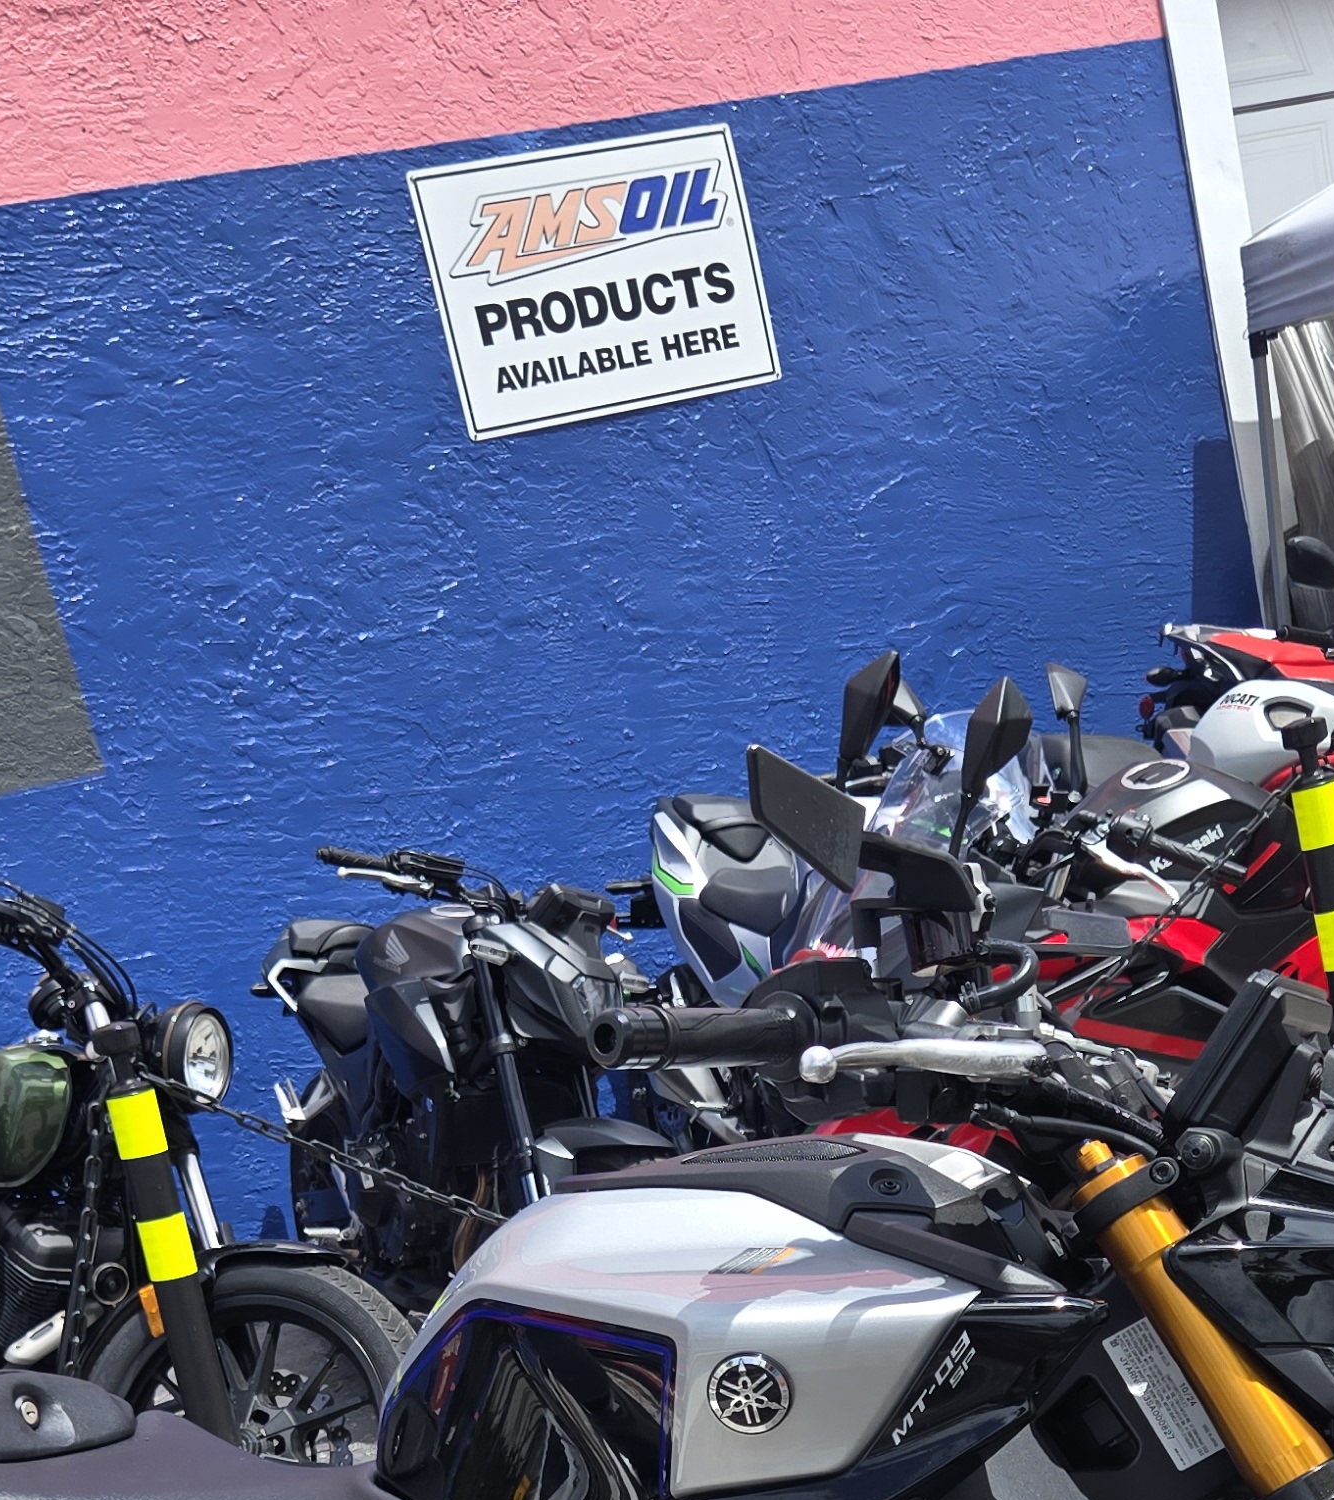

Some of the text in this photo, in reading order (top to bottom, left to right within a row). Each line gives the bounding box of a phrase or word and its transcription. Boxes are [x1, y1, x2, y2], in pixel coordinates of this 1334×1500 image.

[465, 167, 720, 275] AMSOIL
[474, 262, 735, 347] PRODUCTS
[496, 323, 740, 394] AVAILABLE HERE
[891, 1329, 971, 1446] MT-09
[949, 1346, 976, 1389] SP
[1178, 1382, 1198, 1407] 10/24
